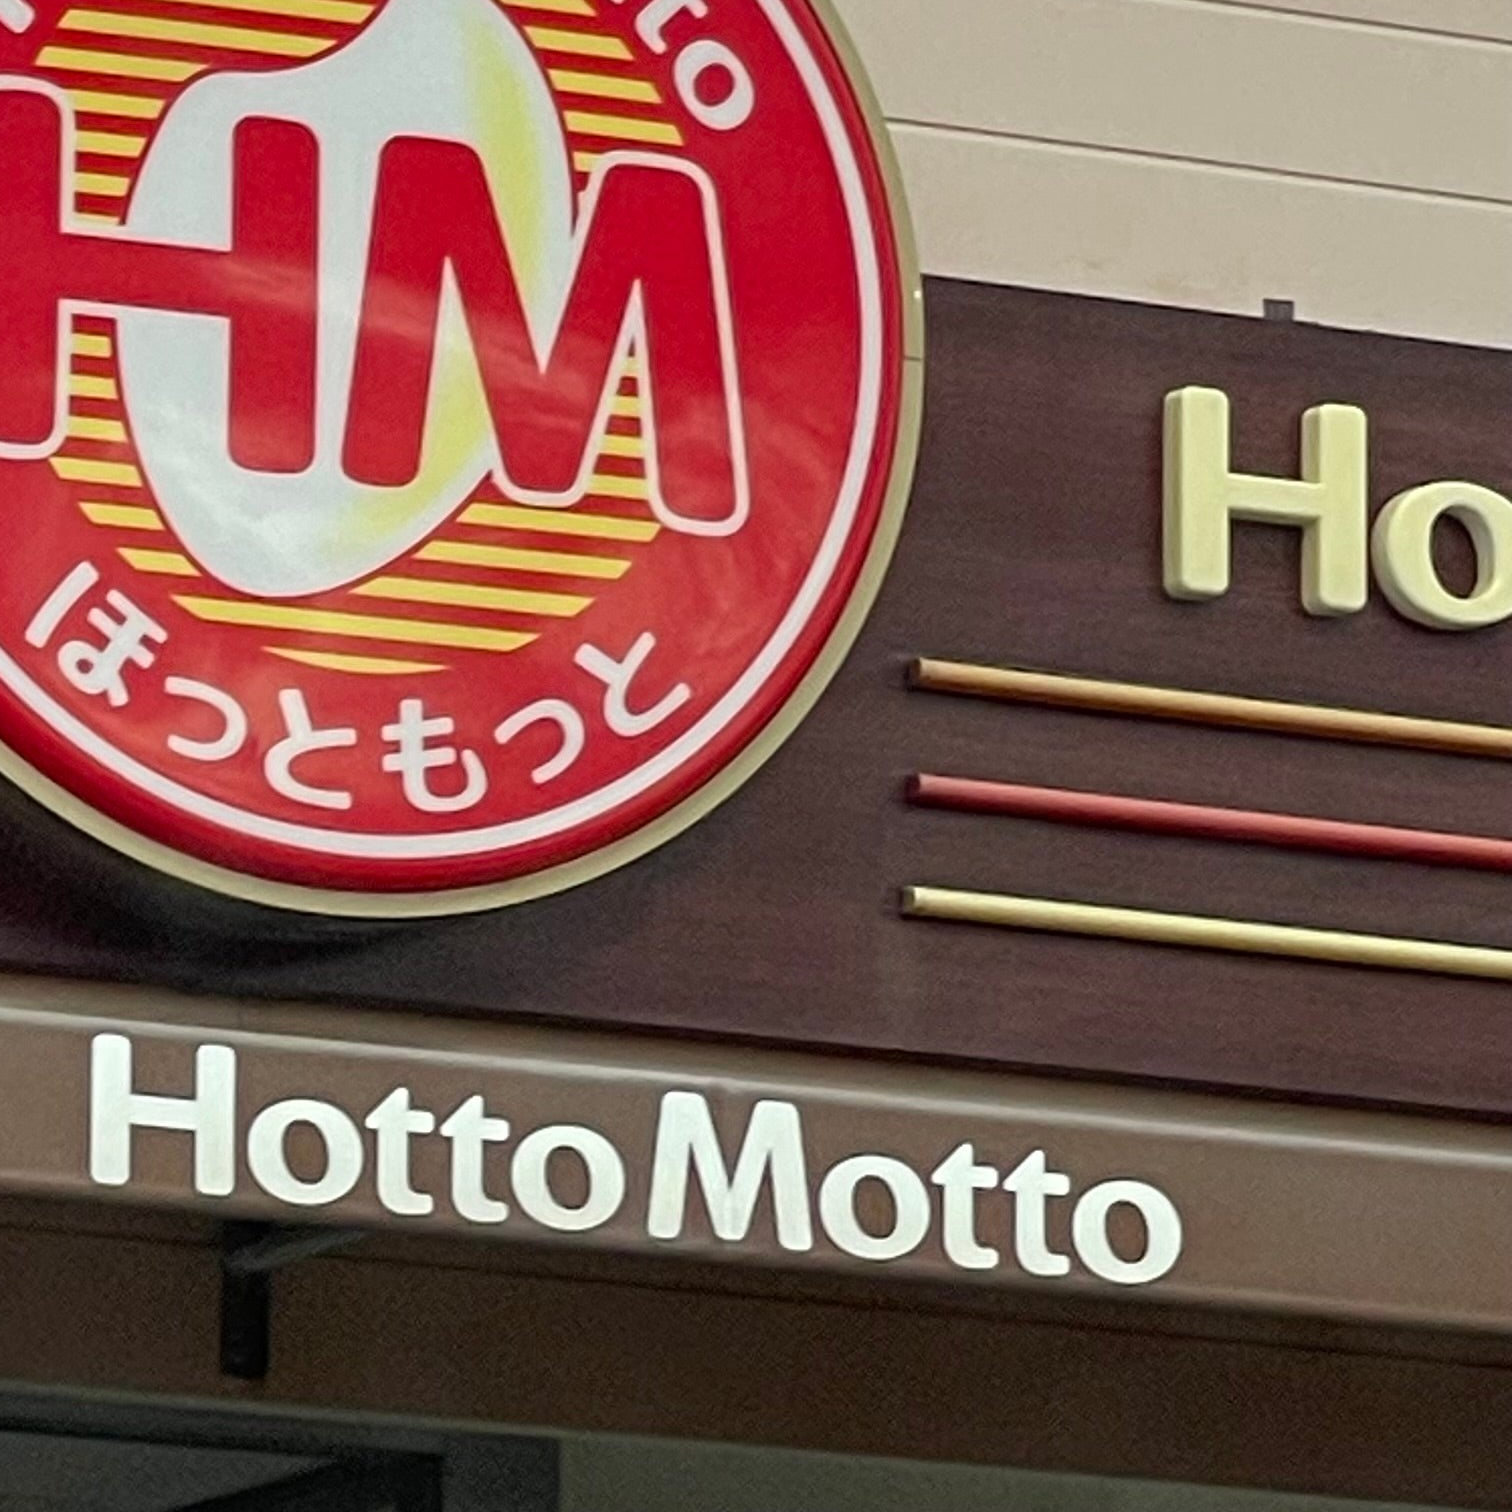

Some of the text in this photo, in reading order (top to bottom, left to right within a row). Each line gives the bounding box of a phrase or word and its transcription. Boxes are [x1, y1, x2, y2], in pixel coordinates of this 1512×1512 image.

[24, 561, 691, 813] ほっともっと
